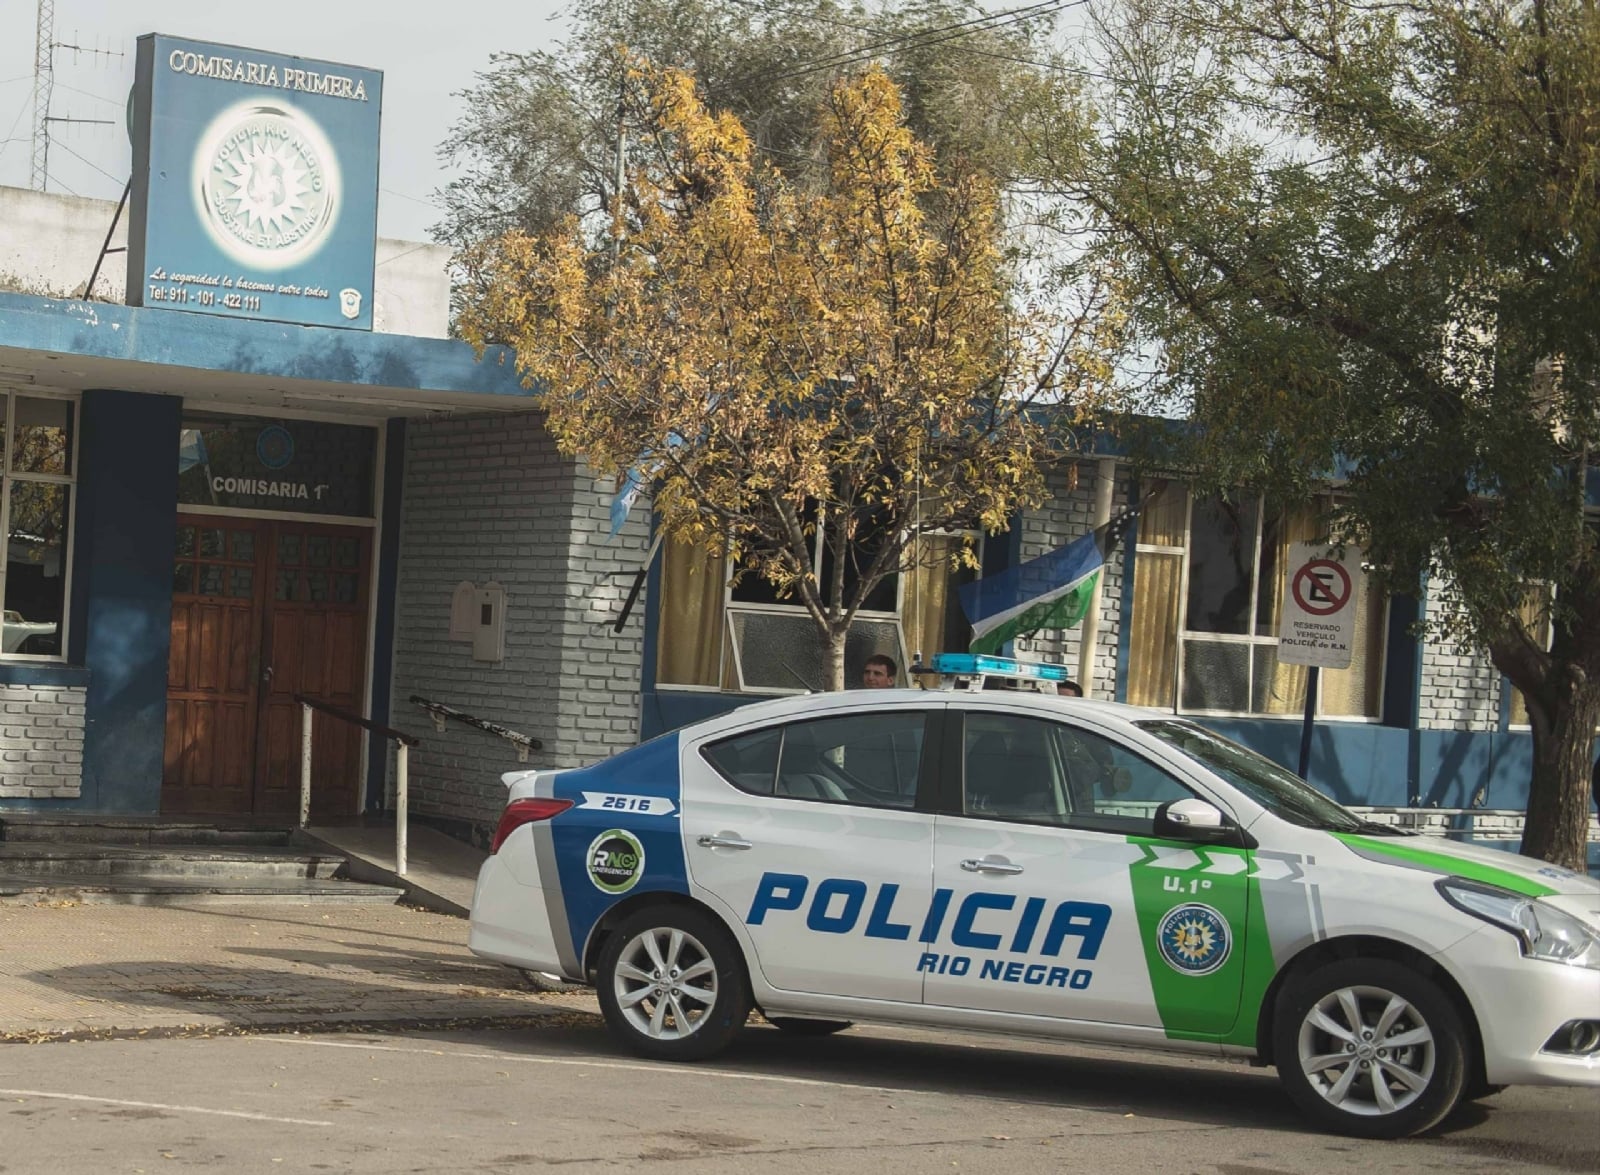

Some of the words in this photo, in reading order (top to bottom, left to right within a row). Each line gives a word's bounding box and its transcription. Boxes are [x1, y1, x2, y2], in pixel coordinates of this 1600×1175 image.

[169, 49, 281, 89] COMISARIA
[283, 67, 369, 102] PRIMERA
[213, 123, 261, 173] POLICIA
[265, 122, 290, 141] RIO
[292, 136, 322, 192] NEGRO
[257, 233, 274, 248] ET
[149, 266, 167, 280] La
[170, 271, 220, 287] seguridad
[222, 275, 233, 287] la
[235, 275, 275, 292] hacemos
[278, 283, 302, 296] entre
[304, 283, 330, 299] todos
[149, 285, 168, 301] Tel:
[169, 287, 188, 302] 911
[197, 290, 214, 306] 101
[223, 293, 241, 308] 422
[244, 294, 261, 311] 111
[212, 476, 309, 499] COMISARIA
[1293, 621, 1341, 632] RESERVADO
[1296, 630, 1336, 641] VEHICULO
[1281, 638, 1317, 648] POLICIA
[1318, 641, 1329, 649] de
[602, 796, 651, 811] 2616
[745, 871, 1114, 961] POLICIA
[1164, 911, 1191, 934] POLICIA
[915, 951, 972, 977] RIO
[979, 958, 1094, 990] NEGRO
